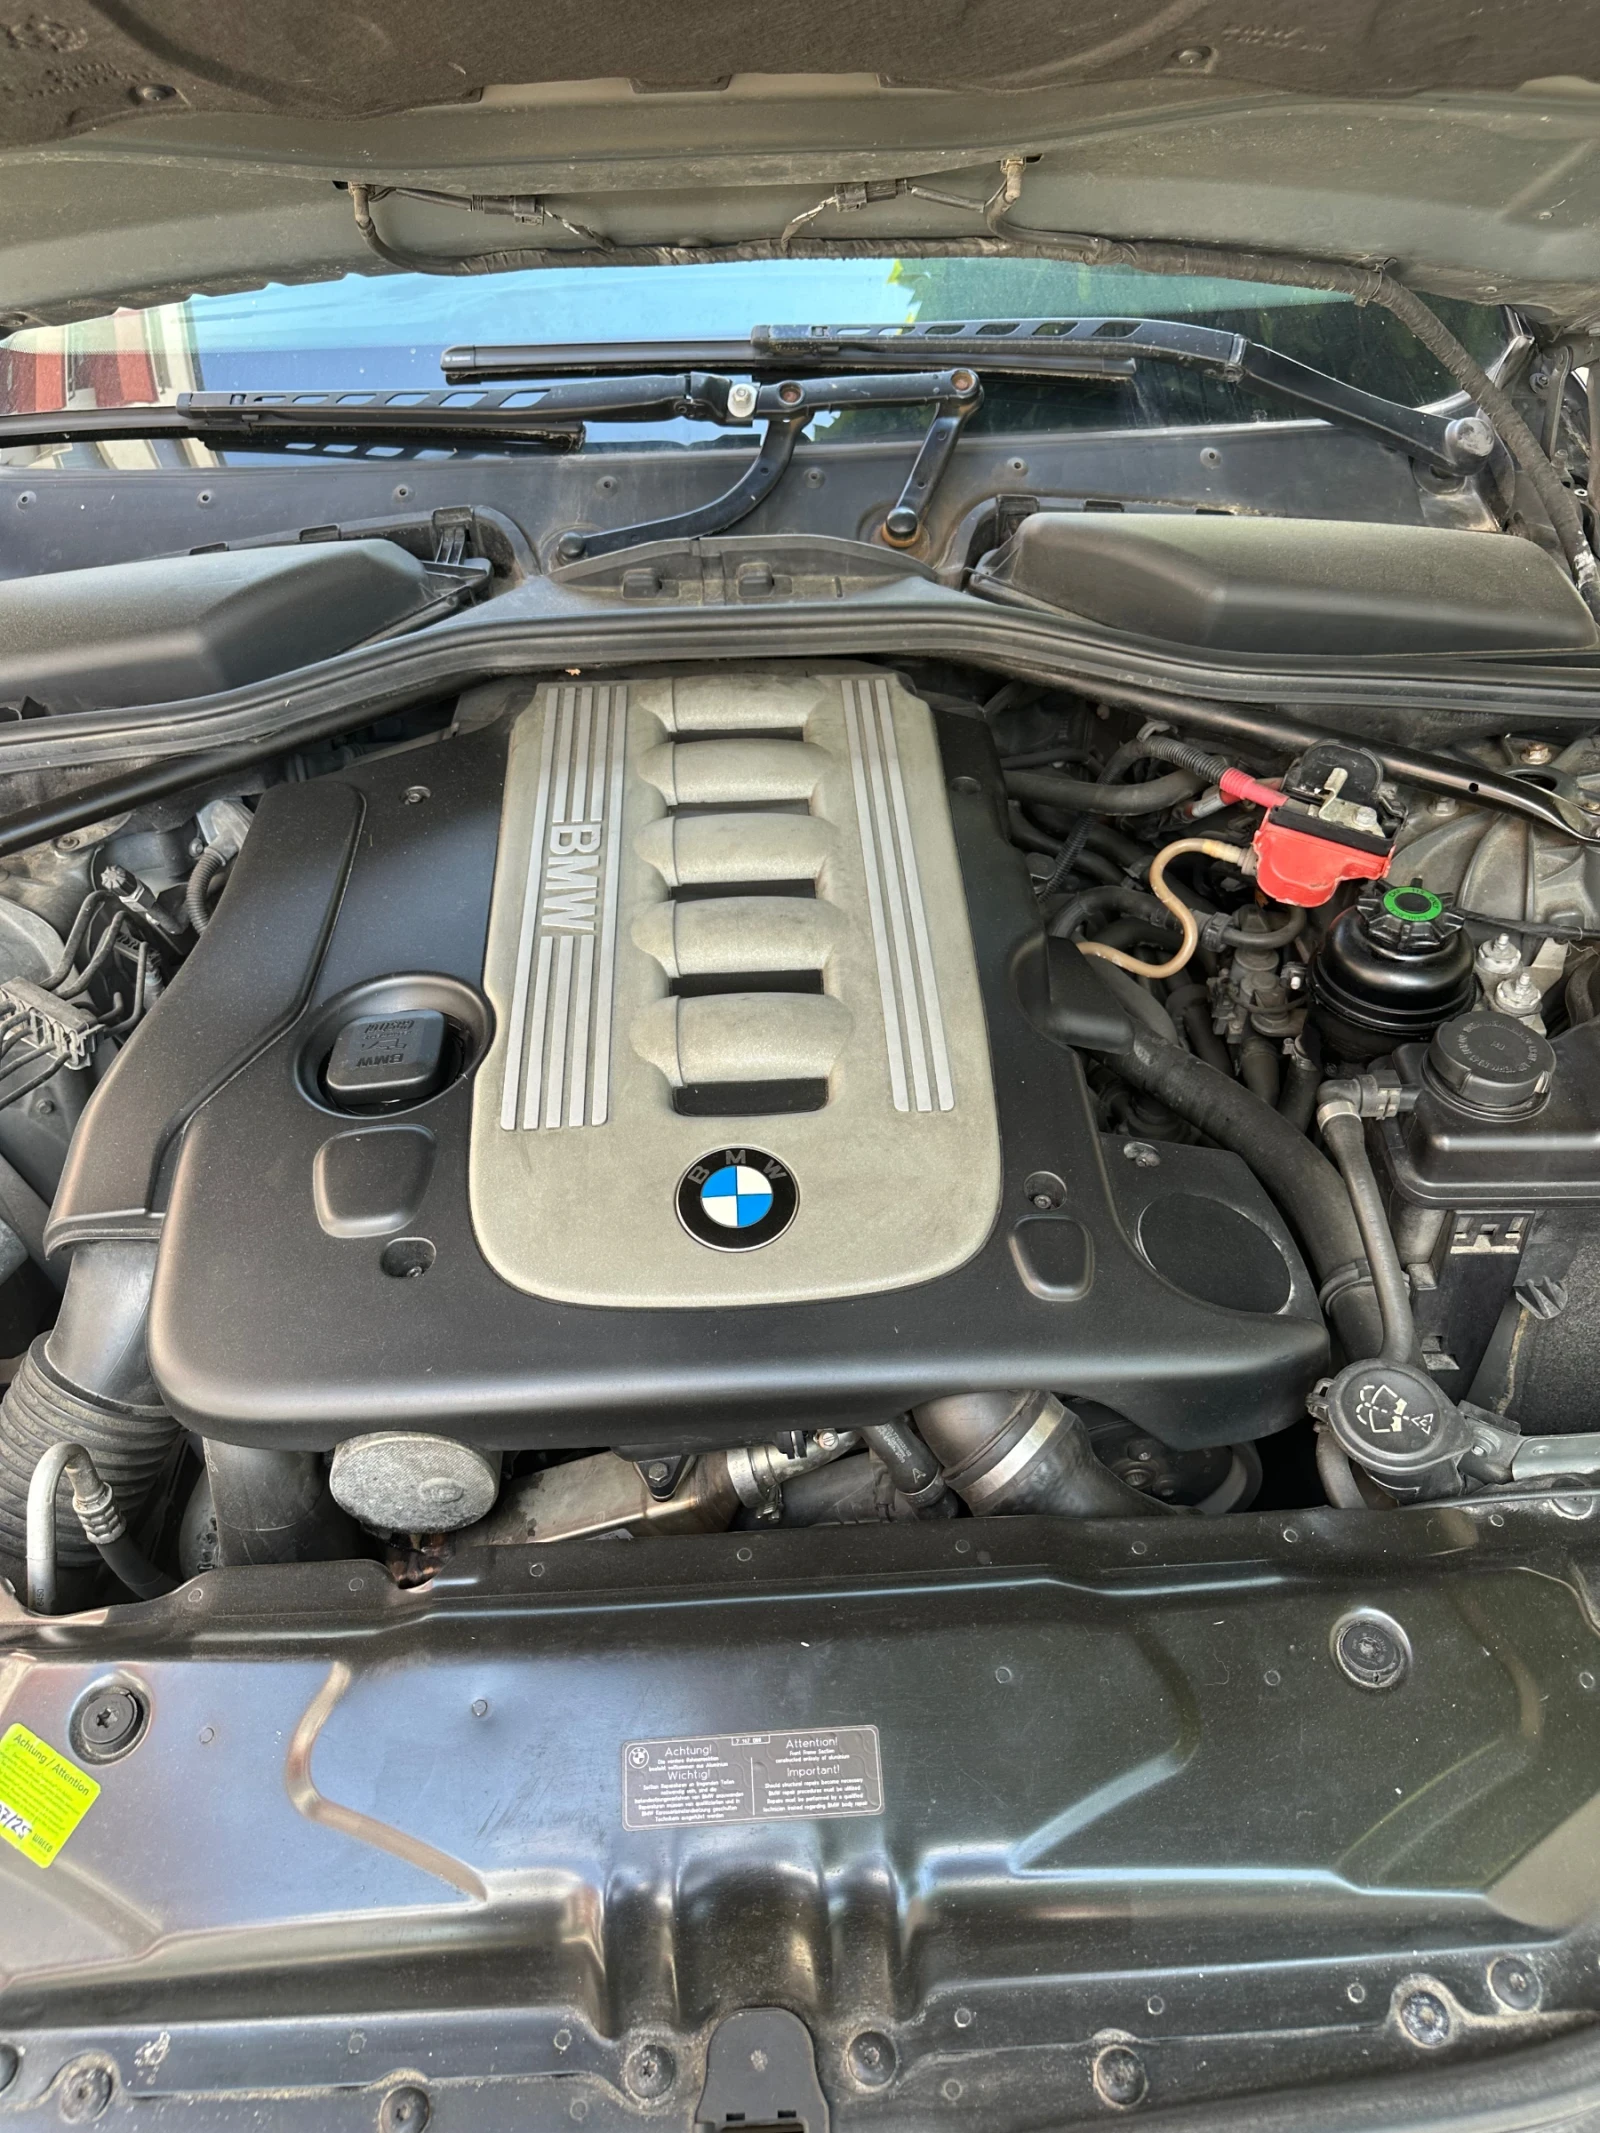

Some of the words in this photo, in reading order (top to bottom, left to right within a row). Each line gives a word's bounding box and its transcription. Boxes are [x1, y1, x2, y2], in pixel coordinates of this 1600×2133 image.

[541, 824, 602, 931] BMW
[356, 1053, 404, 1068] BMW
[687, 1149, 788, 1185] BMW
[785, 1736, 838, 1748] Attention!
[664, 1744, 712, 1757] Achtung!
[13, 1733, 48, 1765] Achtung
[52, 1763, 90, 1797] Attention
[786, 1764, 840, 1778] Important!
[667, 1769, 711, 1781] Wichtig!
